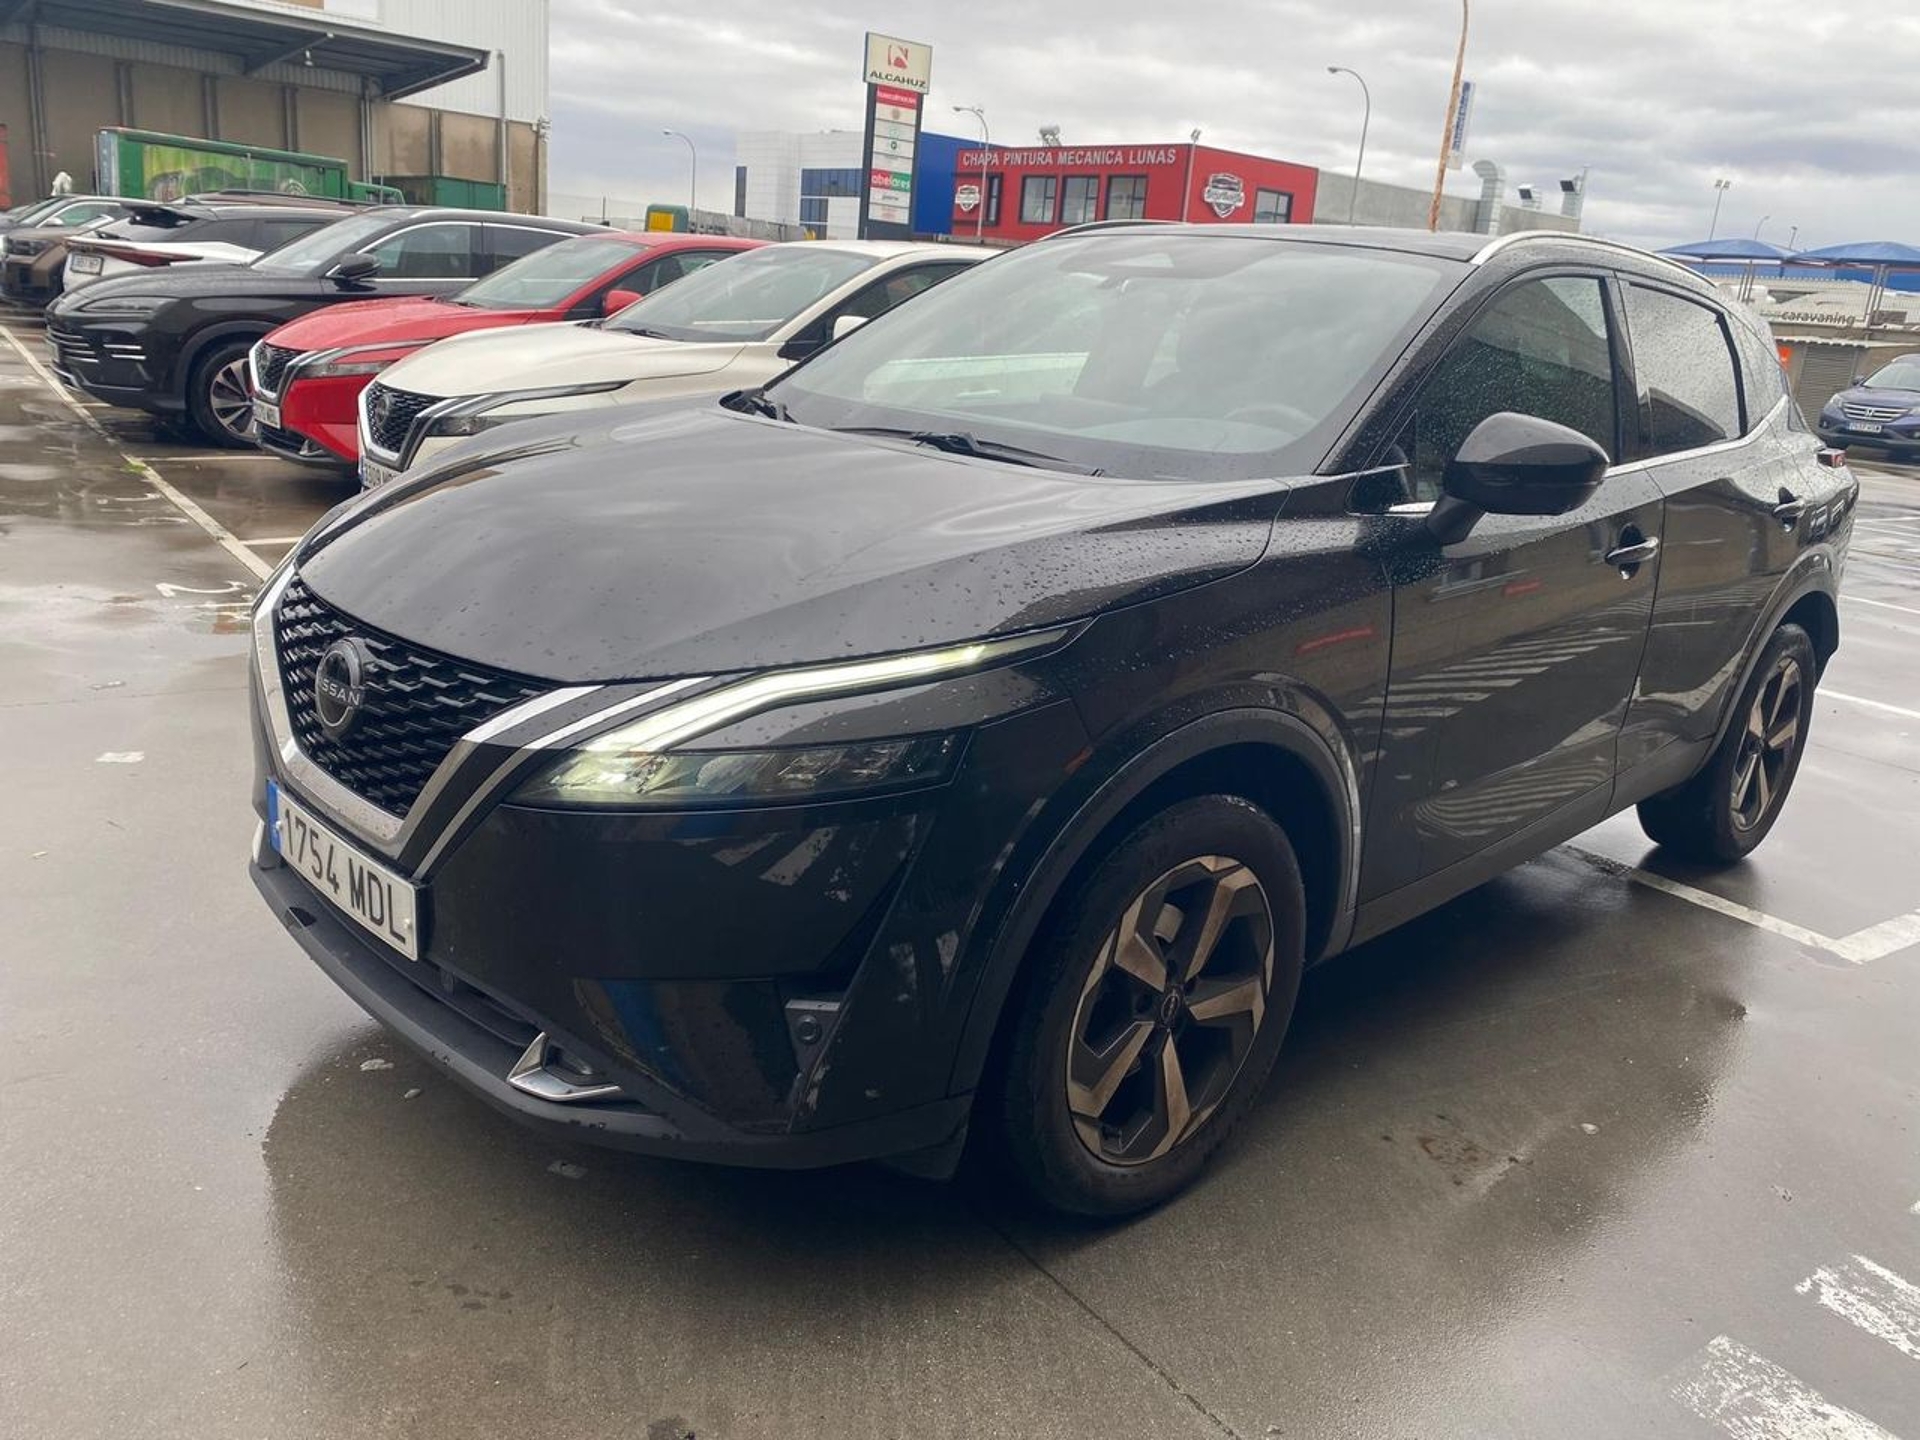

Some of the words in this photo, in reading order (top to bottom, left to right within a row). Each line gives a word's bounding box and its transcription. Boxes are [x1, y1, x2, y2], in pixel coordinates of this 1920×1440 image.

[870, 69, 926, 88] ALCAHUZ
[963, 152, 999, 166] CHAPA
[1003, 151, 1053, 166] PINTURA
[1057, 150, 1123, 165] MECANICA
[1129, 149, 1177, 164] LUNAS
[1781, 311, 1856, 326] caravaning
[285, 808, 340, 895] 1754
[348, 857, 406, 944] MDL
